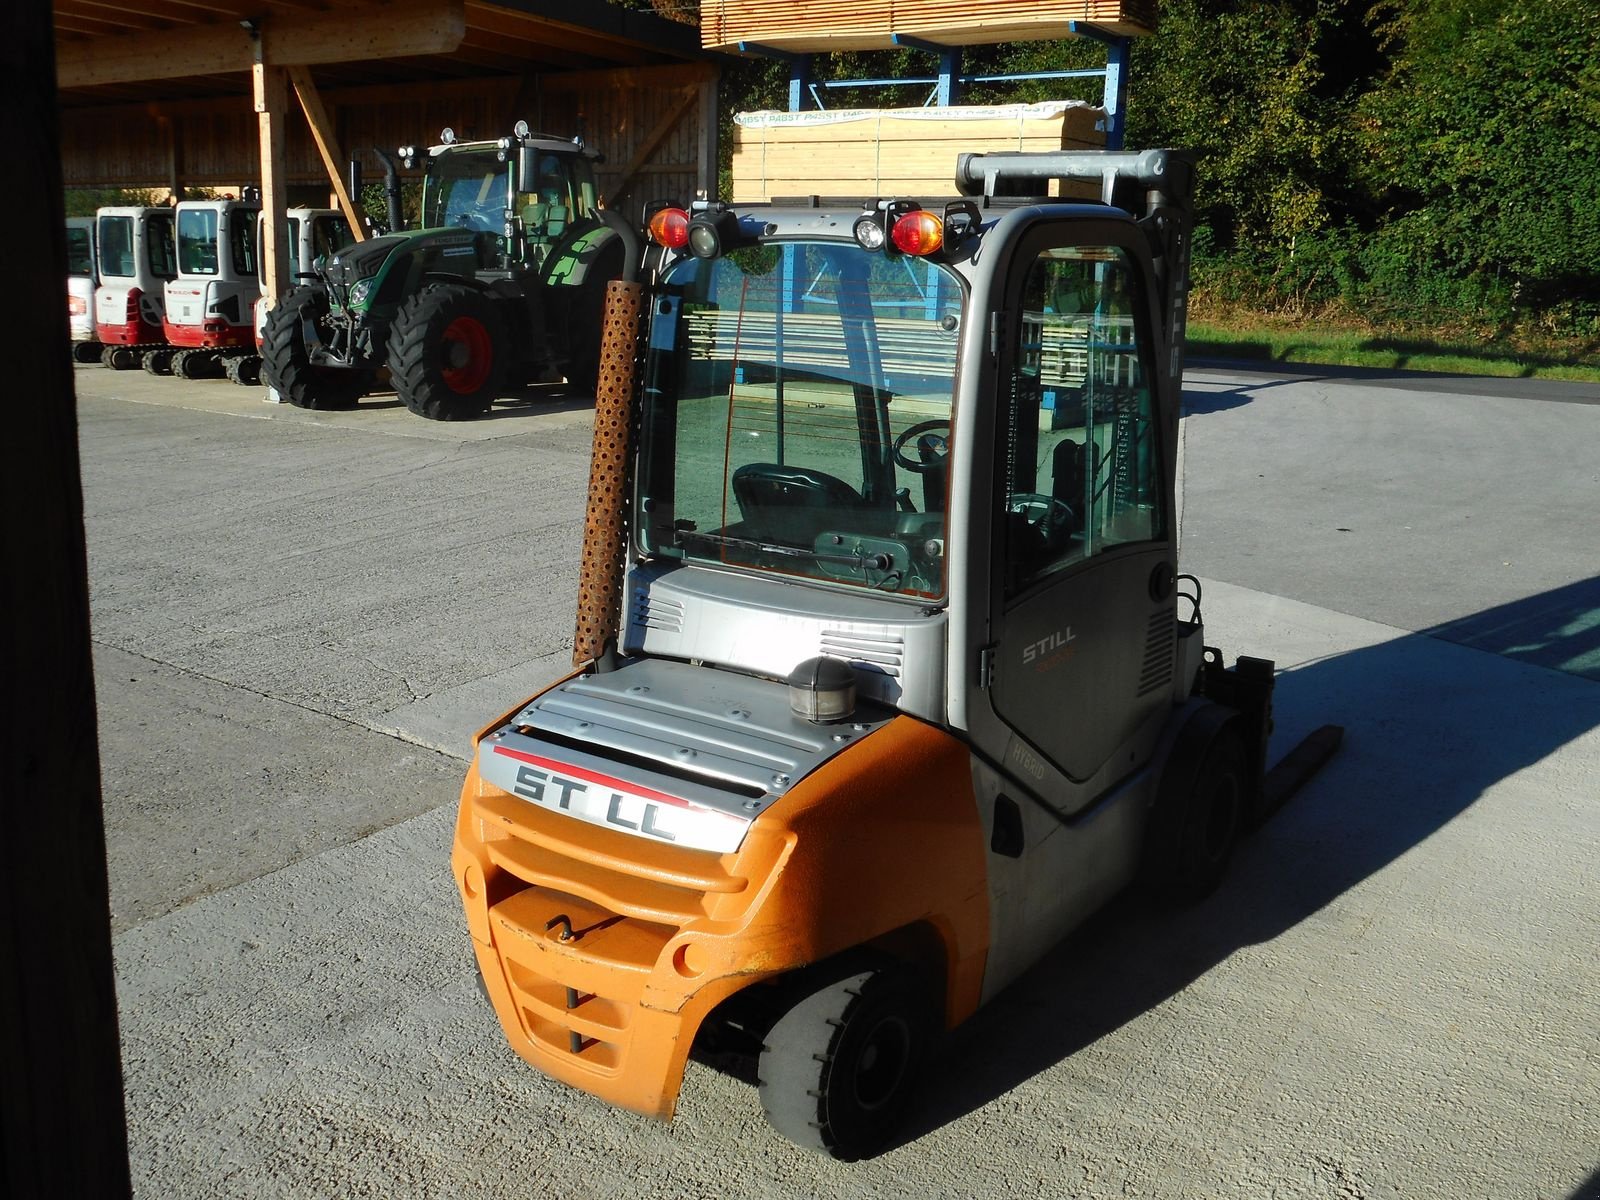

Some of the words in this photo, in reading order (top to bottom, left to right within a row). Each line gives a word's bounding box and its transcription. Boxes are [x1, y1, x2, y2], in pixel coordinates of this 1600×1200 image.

[769, 114, 801, 122] PABST
[1023, 626, 1076, 664] STILL
[514, 765, 676, 841] STLL
